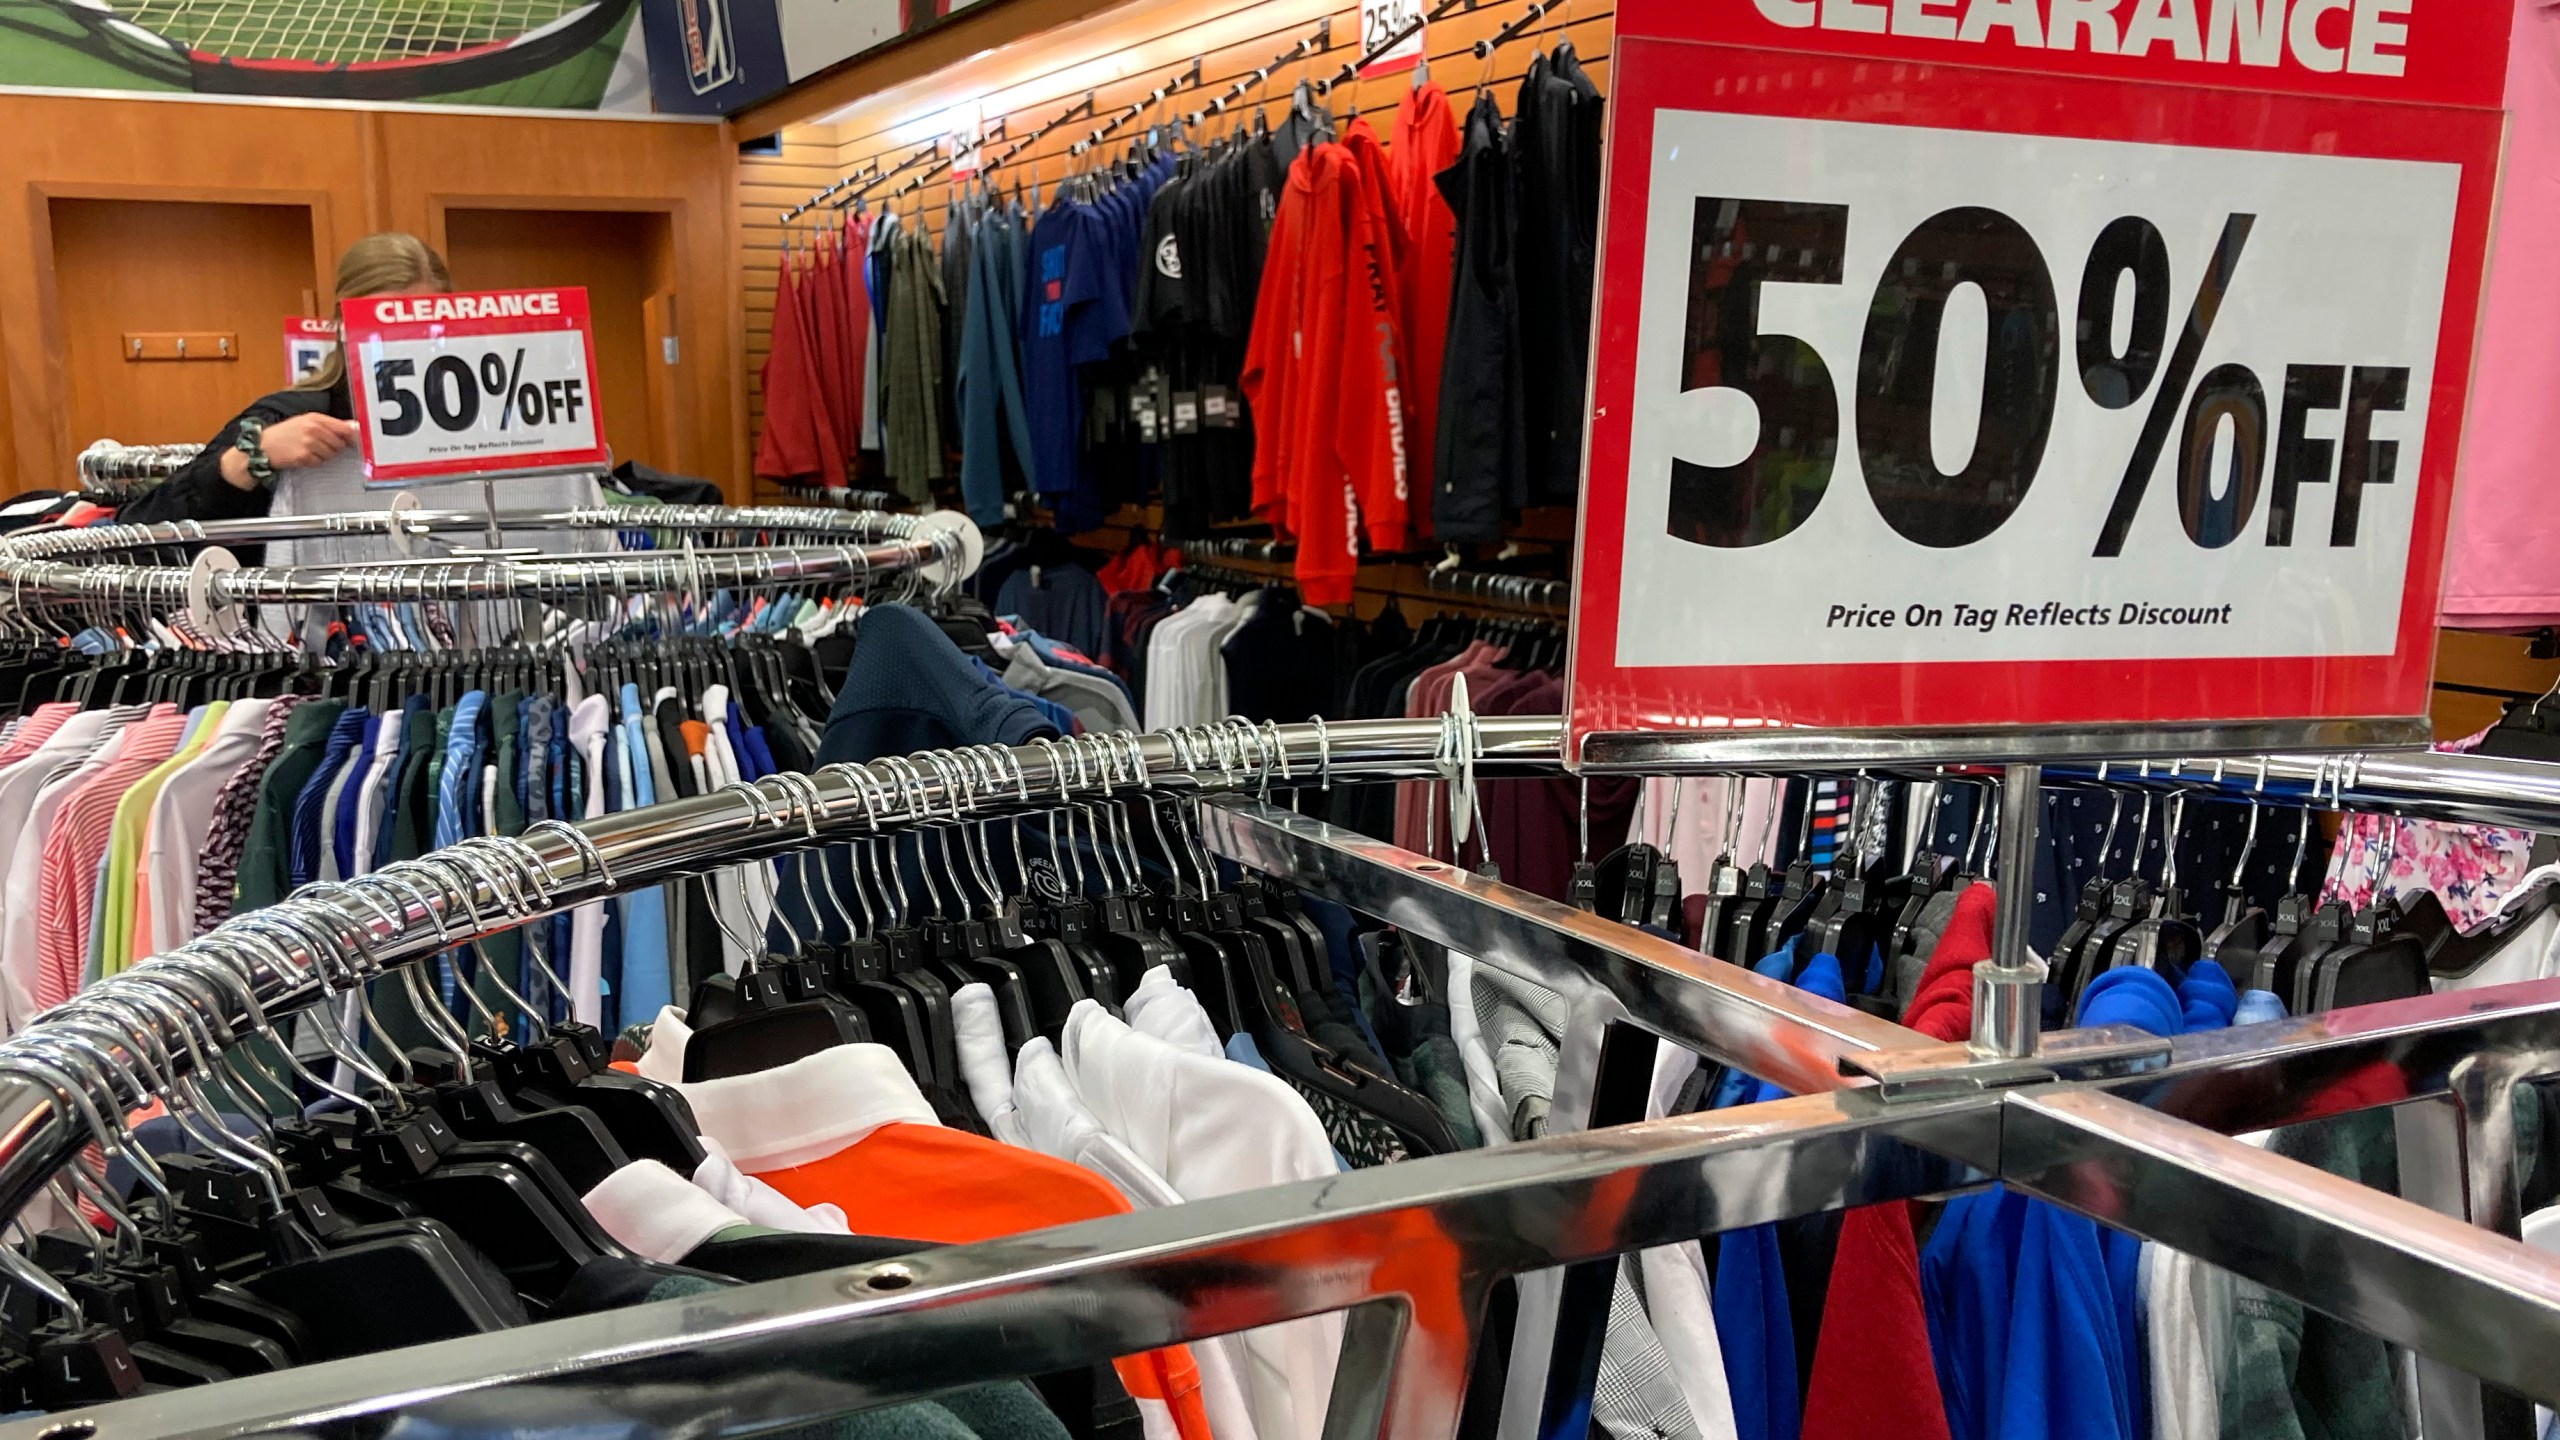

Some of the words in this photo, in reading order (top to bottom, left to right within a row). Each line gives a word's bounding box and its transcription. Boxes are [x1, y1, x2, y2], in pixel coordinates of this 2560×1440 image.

[375, 292, 560, 324] CLEARANCE
[1827, 604, 1895, 628] Price
[1904, 604, 1942, 627] On
[1953, 604, 1997, 633] Tag
[2005, 603, 2111, 626] Reflects
[2118, 602, 2231, 625] Discount
[1162, 806, 1181, 834] XXL
[1628, 869, 1645, 879] XXL
[1834, 868, 1846, 879] XL
[1576, 879, 1595, 888] XXL
[1749, 881, 1763, 889] XXL
[1912, 875, 1930, 885] XXL
[1844, 891, 1861, 900] XXL
[2114, 895, 2131, 906] 2XL
[1183, 911, 1191, 921] L
[1213, 911, 1221, 921] L
[2278, 914, 2297, 923] XXL
[1023, 919, 1036, 928] XL
[1066, 923, 1077, 932] XL
[2320, 919, 2338, 928] XXL
[2355, 924, 2371, 934] XXL
[1008, 927, 1018, 938] L
[975, 937, 984, 948] L
[898, 948, 906, 959] L
[768, 983, 778, 994] L
[805, 977, 816, 989] L
[744, 984, 753, 1001] L
[590, 1045, 601, 1058] L
[537, 1056, 549, 1073] L
[569, 1055, 579, 1065] L
[513, 1063, 523, 1075] L
[492, 1092, 504, 1105] L
[460, 1101, 475, 1121] L
[429, 1123, 443, 1136] L
[322, 1147, 332, 1160] L
[379, 1144, 393, 1164] L
[415, 1143, 426, 1154] L
[208, 1180, 219, 1200] L
[246, 1185, 256, 1198] L
[313, 1204, 326, 1216] L
[194, 1257, 205, 1272] L
[165, 1286, 177, 1305] L
[124, 1306, 134, 1323] L
[63, 1355, 80, 1381] L
[115, 1357, 127, 1370] L
[23, 1388, 32, 1404] L
